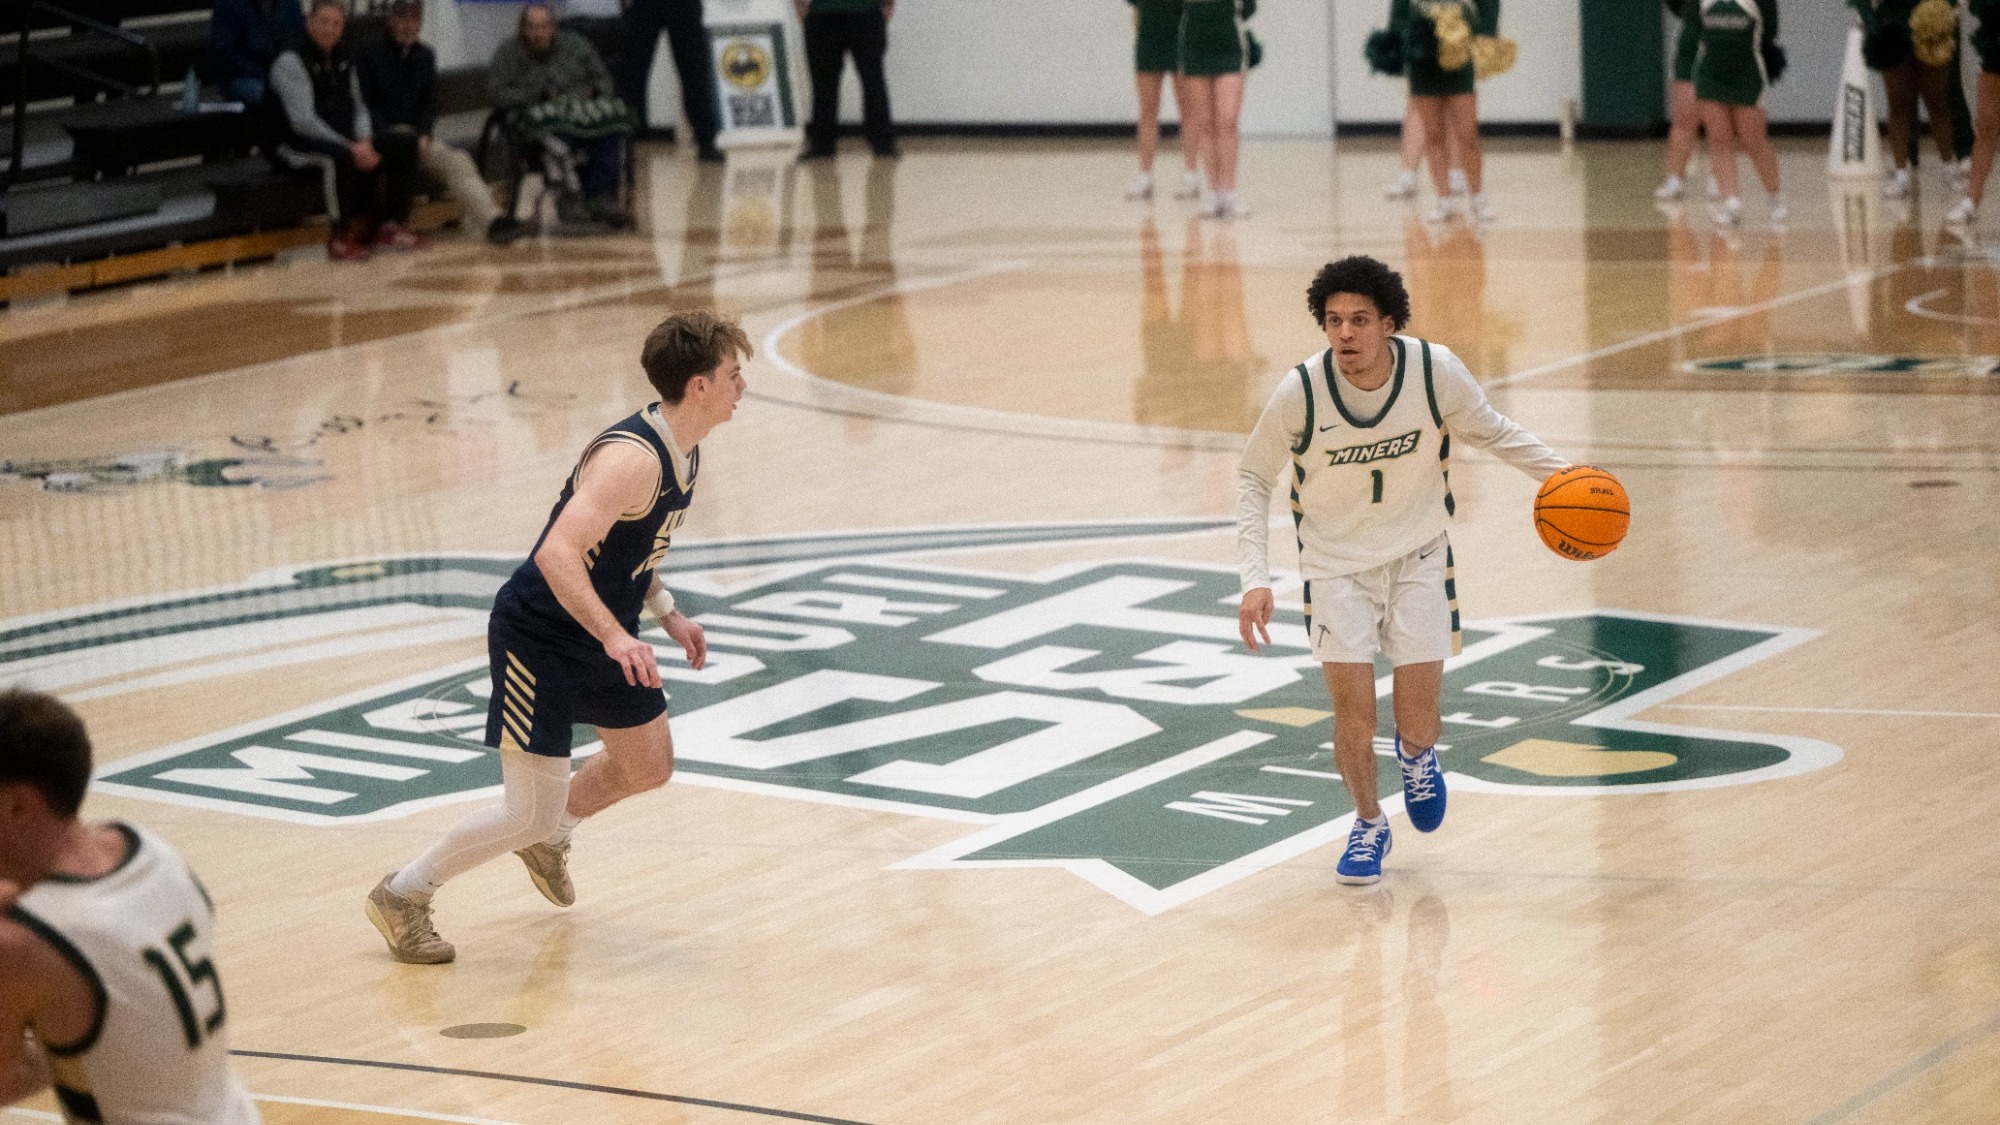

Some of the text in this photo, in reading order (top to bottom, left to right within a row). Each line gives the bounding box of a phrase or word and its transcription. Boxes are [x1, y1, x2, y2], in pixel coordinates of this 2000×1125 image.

[1331, 431, 1418, 464] MINERS
[1371, 469, 1384, 503] 1
[142, 920, 225, 1047] 15
